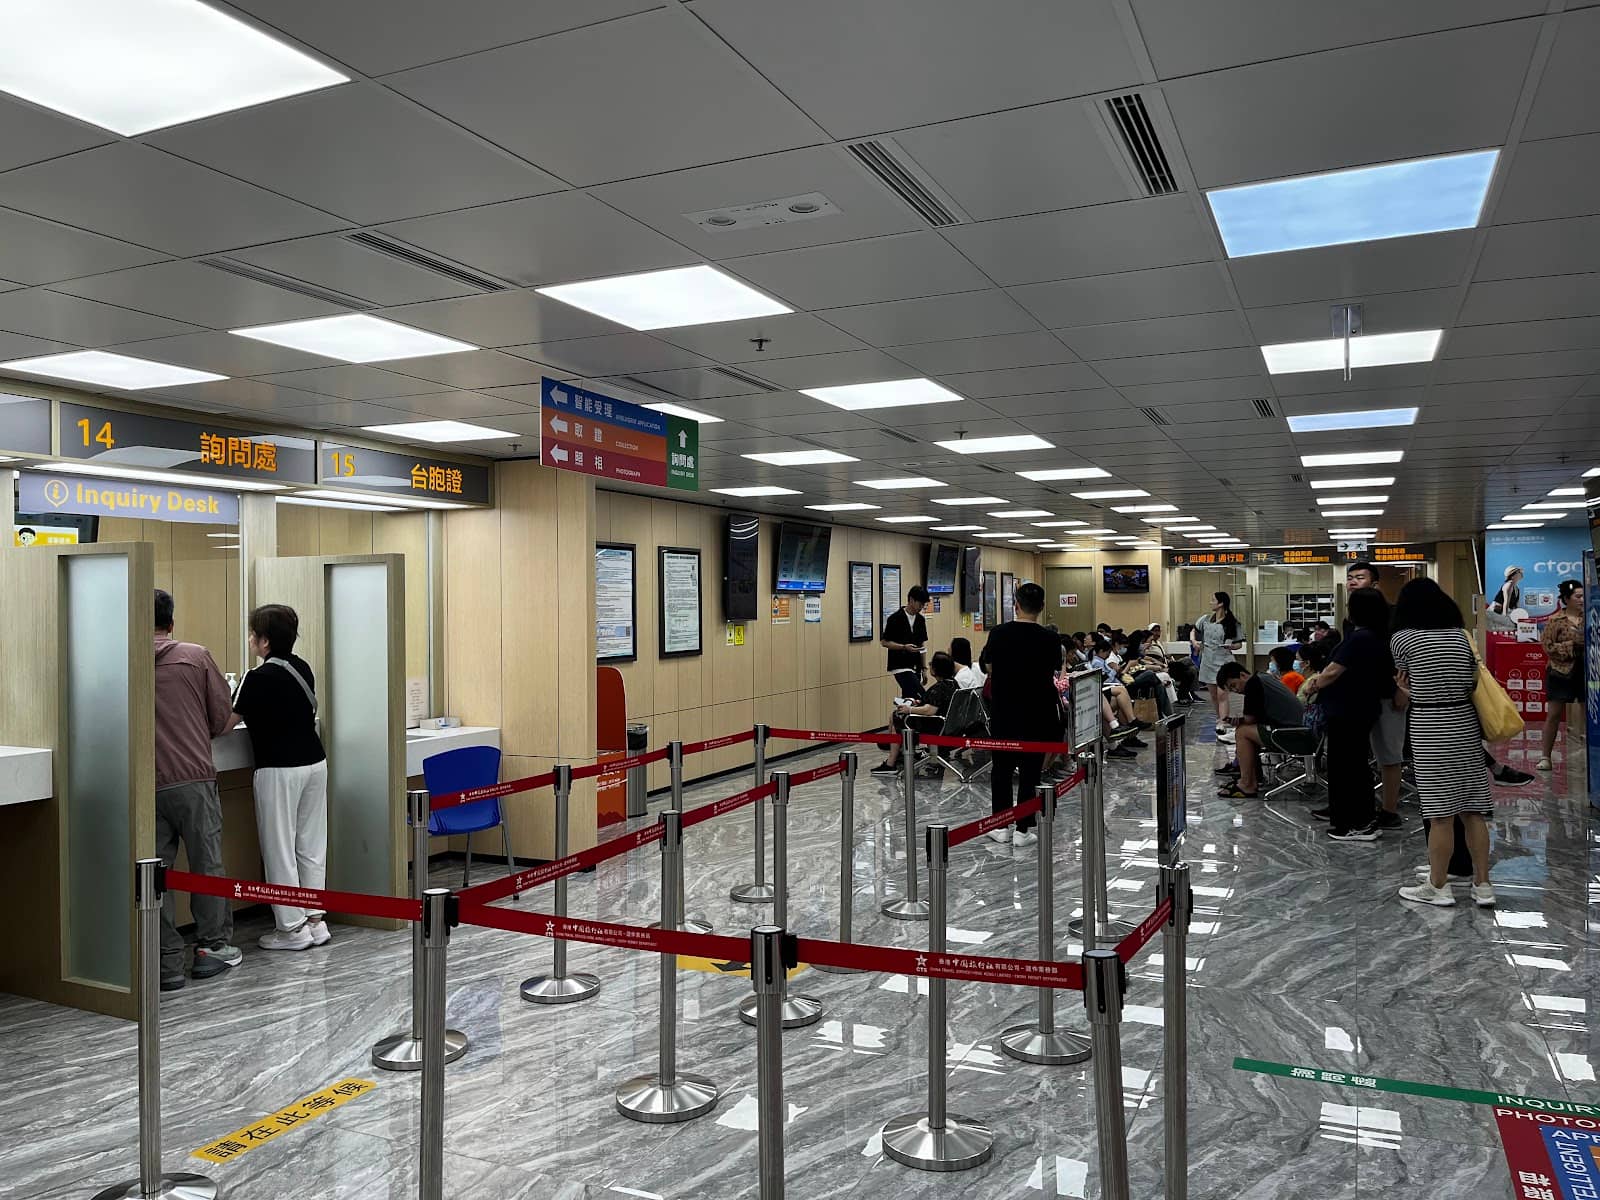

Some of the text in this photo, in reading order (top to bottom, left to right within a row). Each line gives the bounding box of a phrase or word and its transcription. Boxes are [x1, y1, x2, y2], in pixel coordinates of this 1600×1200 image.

[77, 418, 115, 449] 14
[199, 431, 278, 472] 詢問處
[331, 451, 356, 477] 15
[410, 463, 463, 494] 台胞證
[76, 483, 219, 514] Inquiry Desk
[1174, 555, 1184, 563] 16
[1346, 551, 1357, 560] 18
[204, 1082, 368, 1158] 請在此等候
[1496, 1108, 1600, 1129] PHOTO
